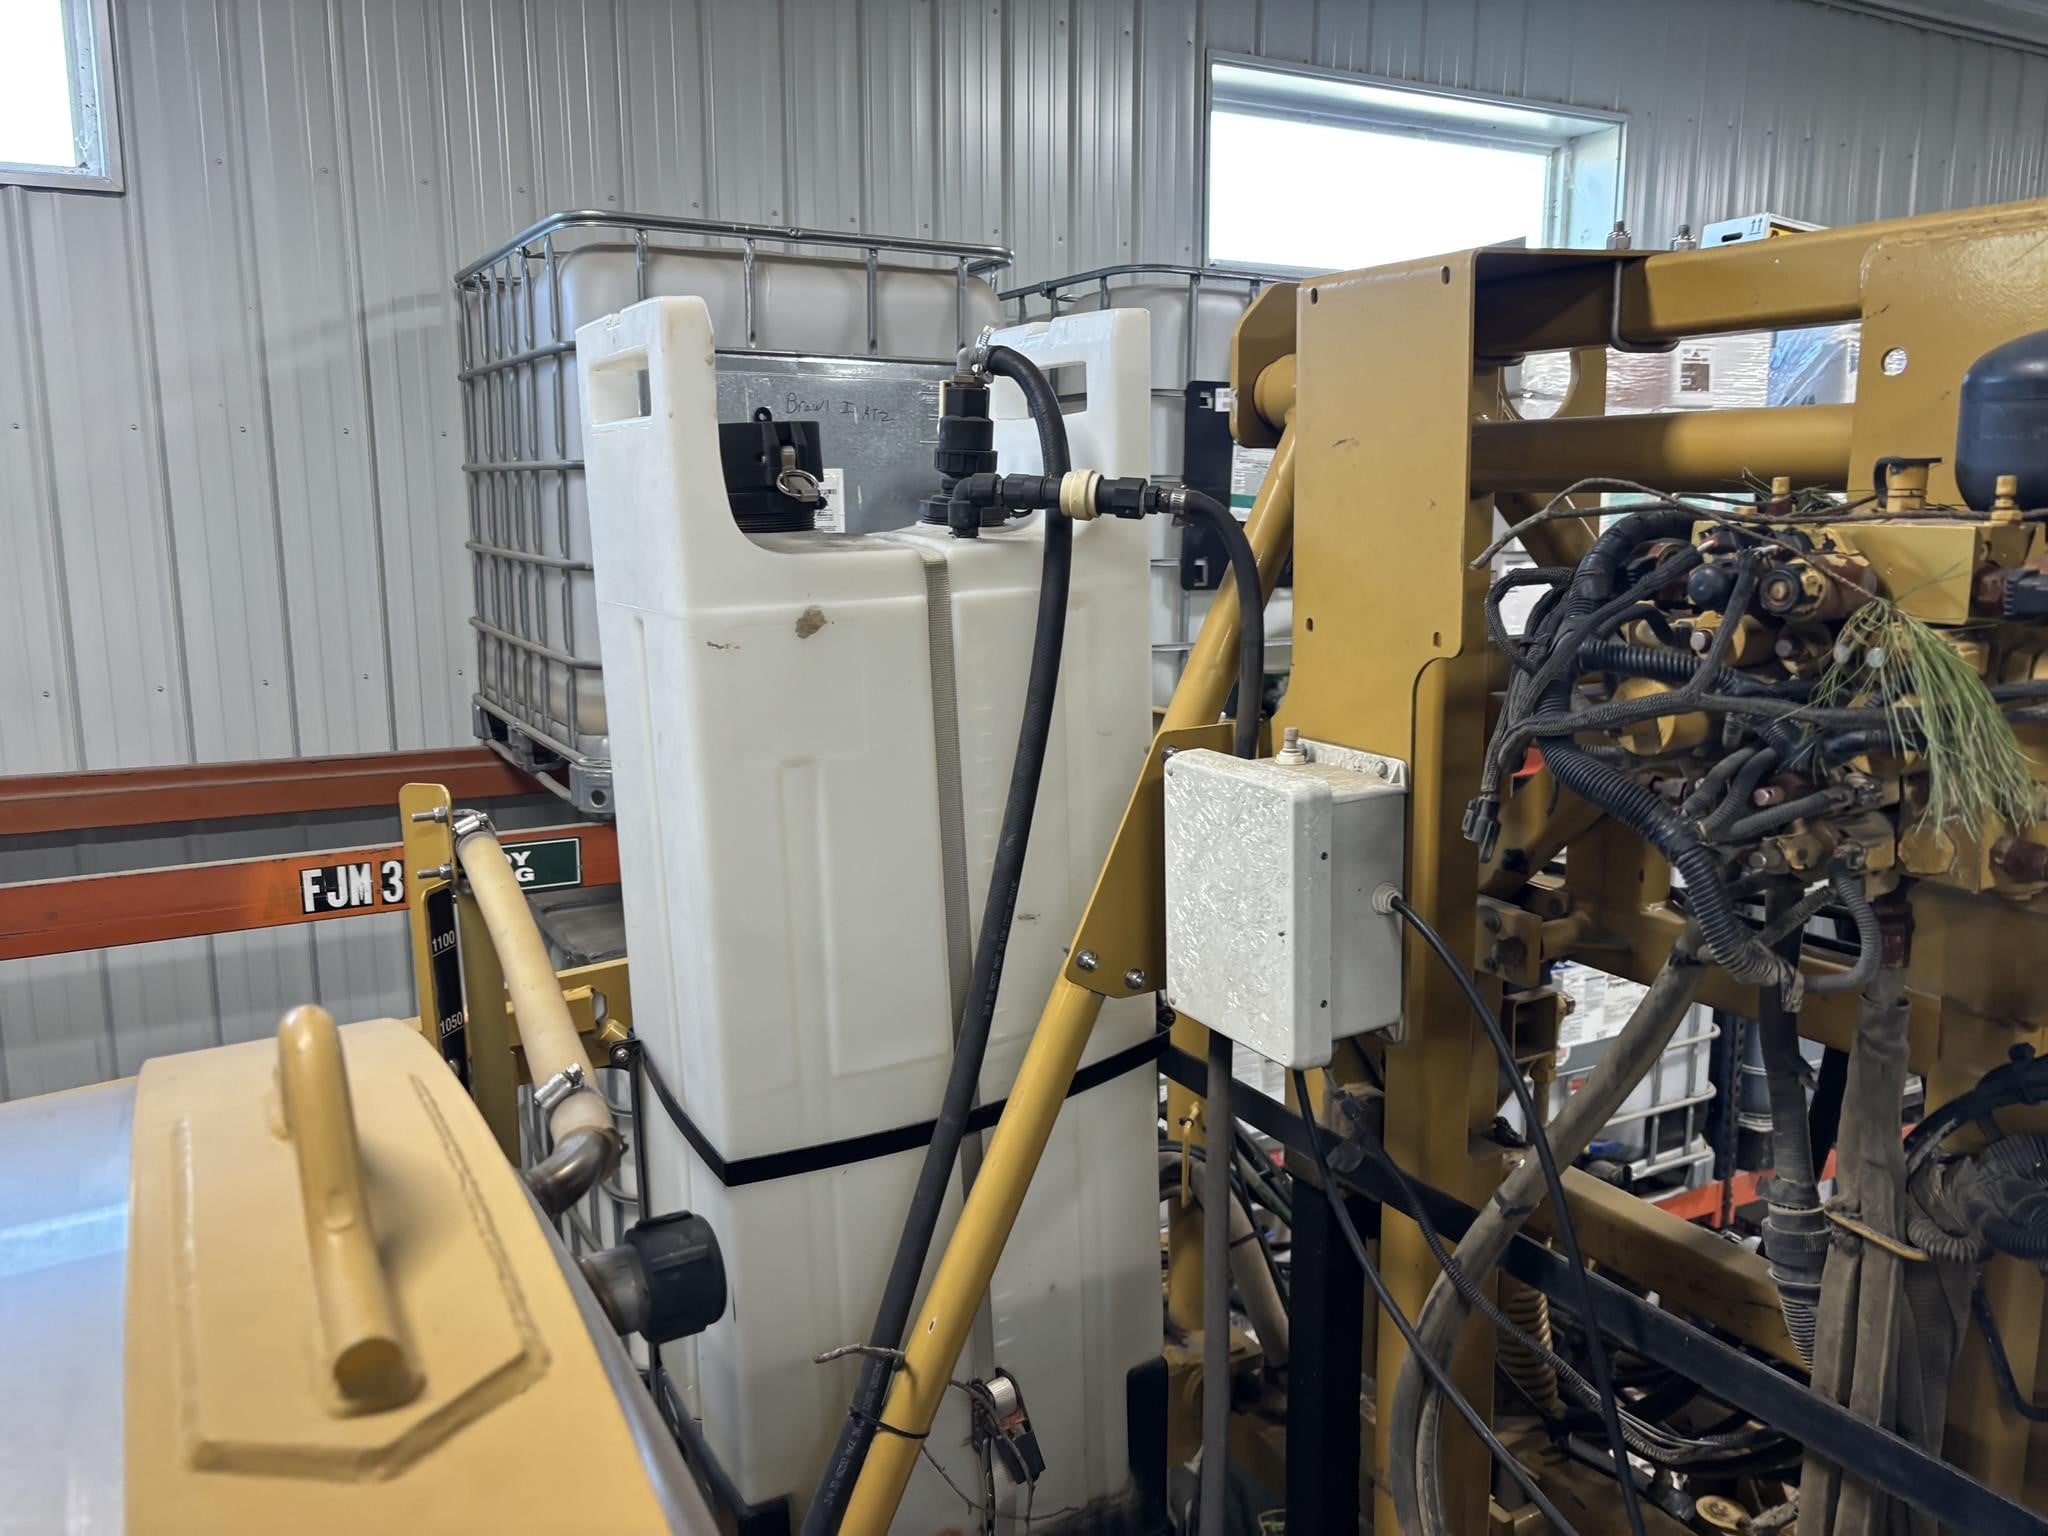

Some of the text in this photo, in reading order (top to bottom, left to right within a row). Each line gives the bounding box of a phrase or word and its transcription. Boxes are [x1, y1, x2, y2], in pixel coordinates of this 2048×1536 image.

[301, 861, 404, 912] FJM 3
[432, 930, 455, 952] 1100
[441, 1012, 463, 1034] 1050
